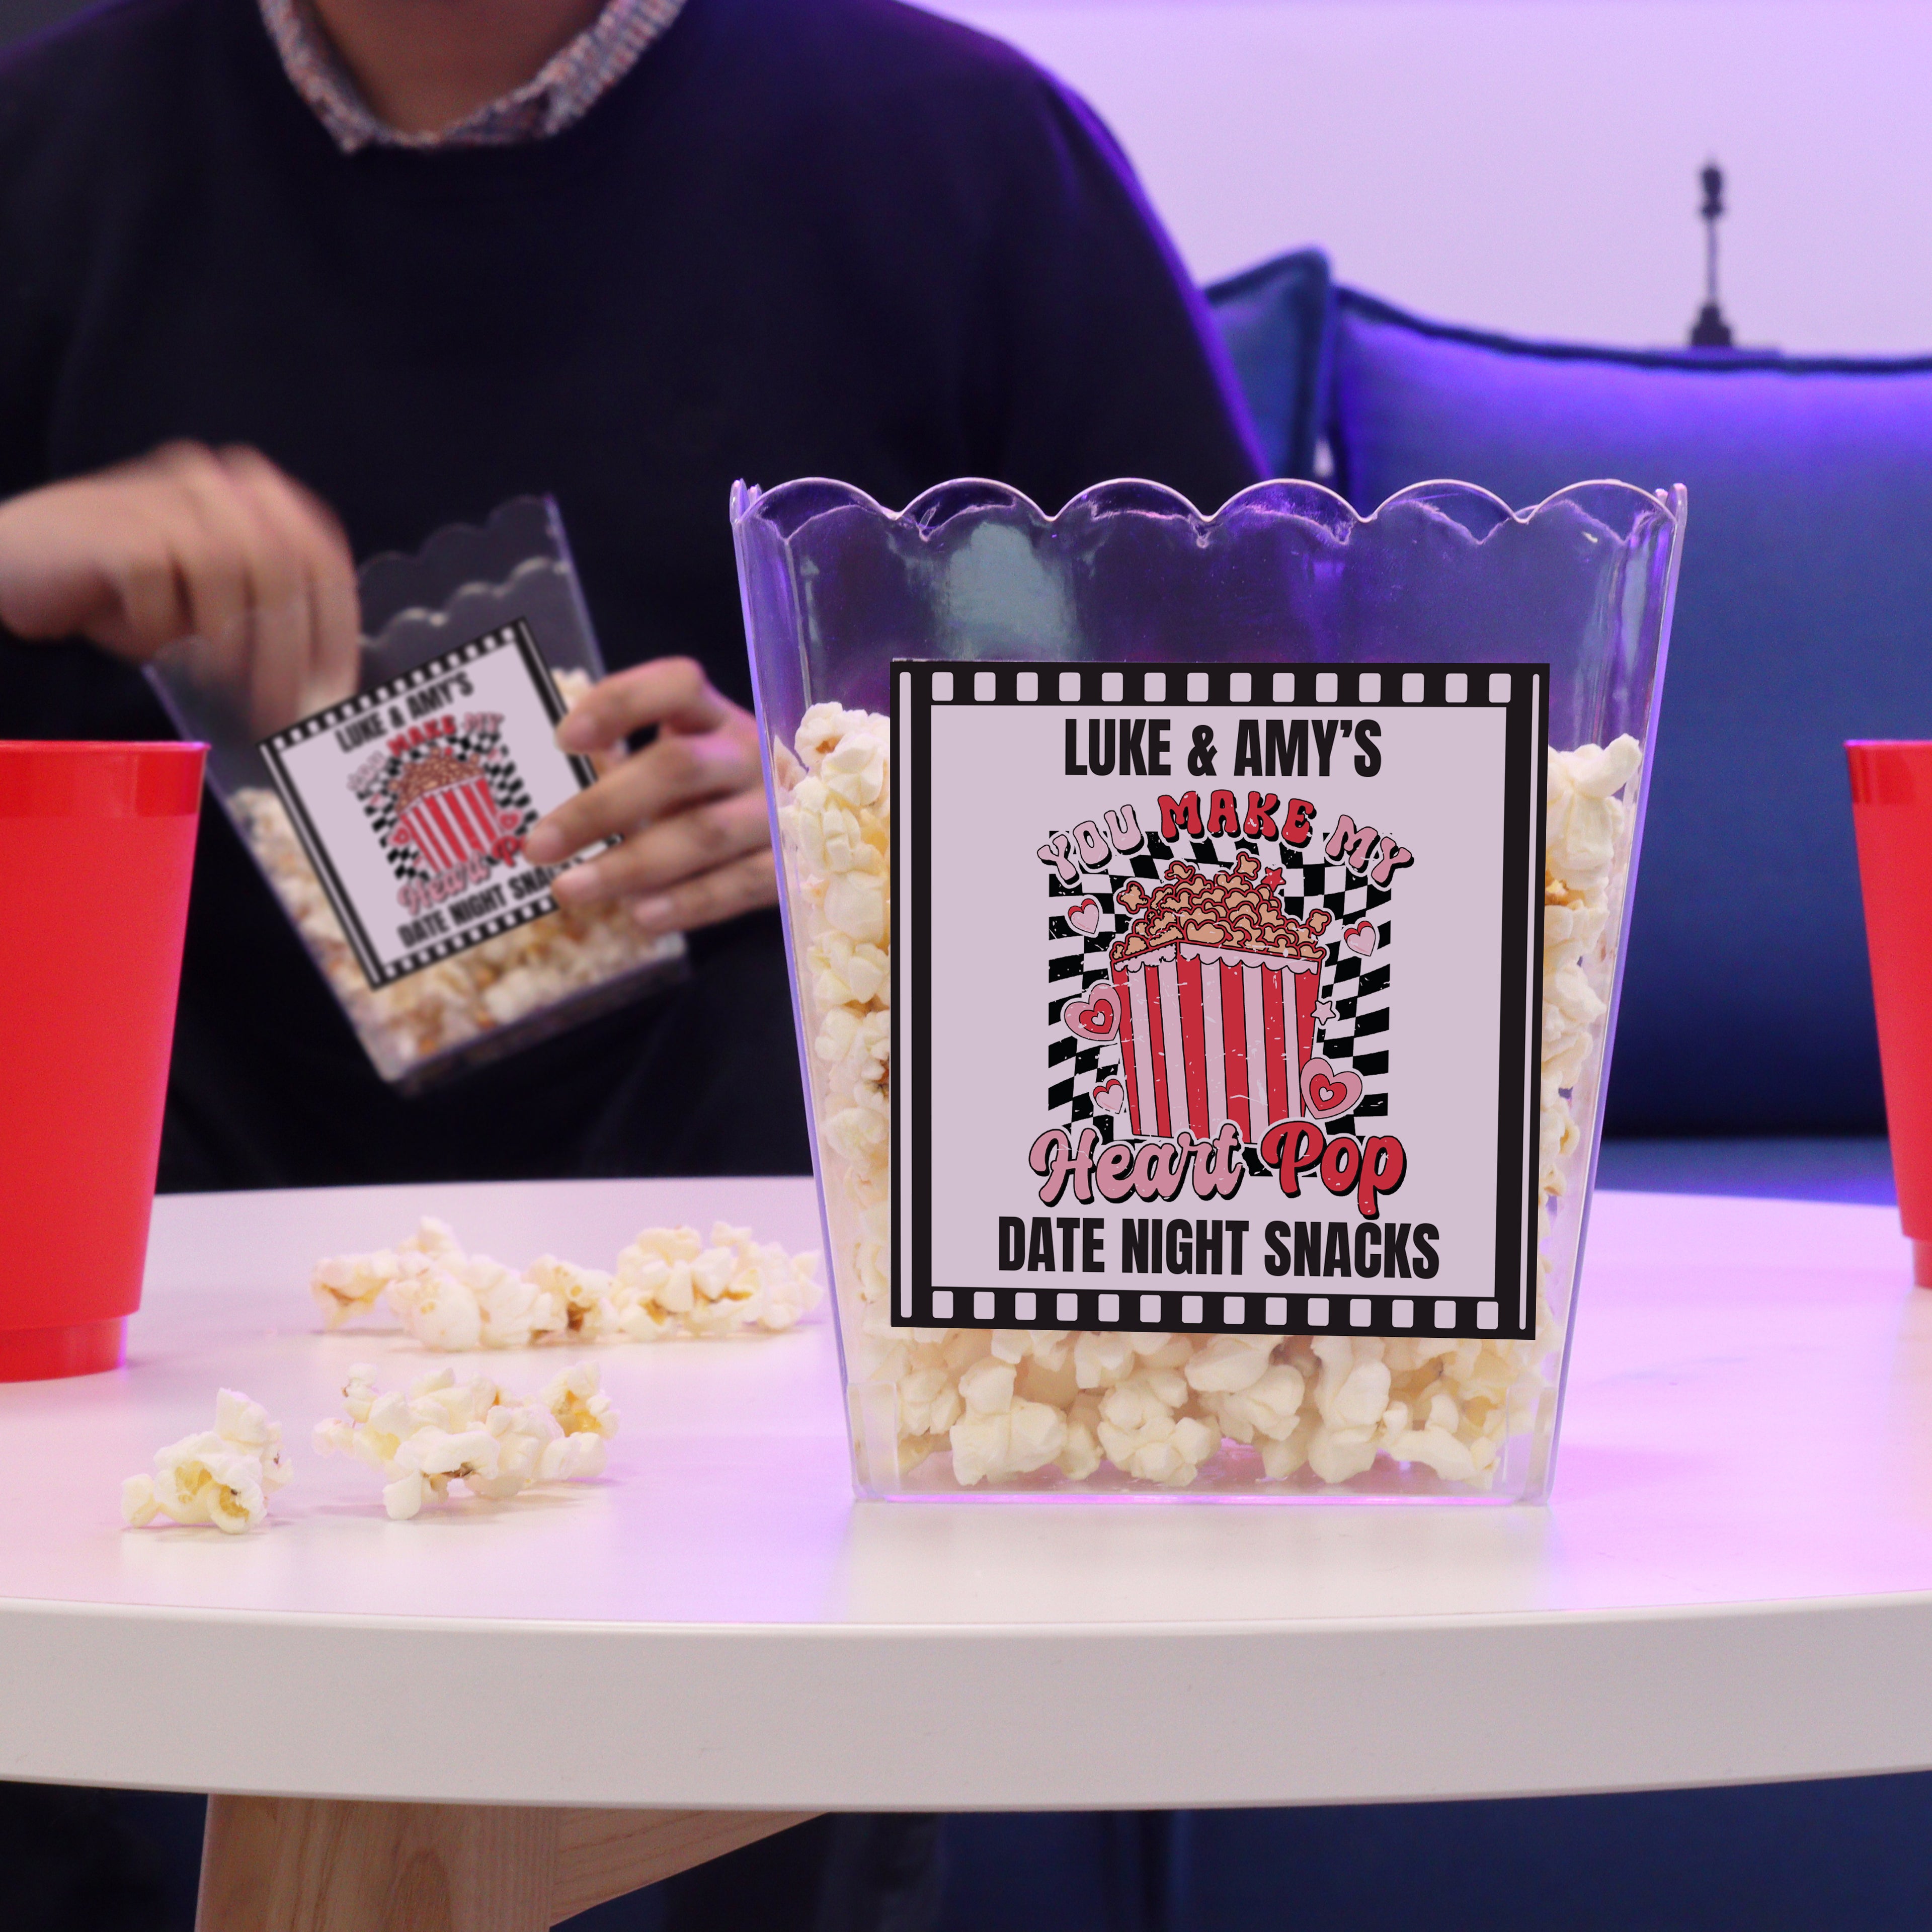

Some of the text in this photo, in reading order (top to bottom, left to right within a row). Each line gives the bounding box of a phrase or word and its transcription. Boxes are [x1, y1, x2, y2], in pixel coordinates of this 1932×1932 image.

[335, 711, 386, 753] LUKE
[387, 714, 455, 757] MAKE
[1064, 718, 1382, 777] LUKE & AMY’S
[1037, 789, 1415, 889] YOU MAKE MY
[397, 910, 449, 948] DATE
[449, 884, 507, 926] NIGHT
[1028, 1120, 1408, 1220] Heart Pop
[999, 1216, 1440, 1279] DATE NIGHT SNACKS
